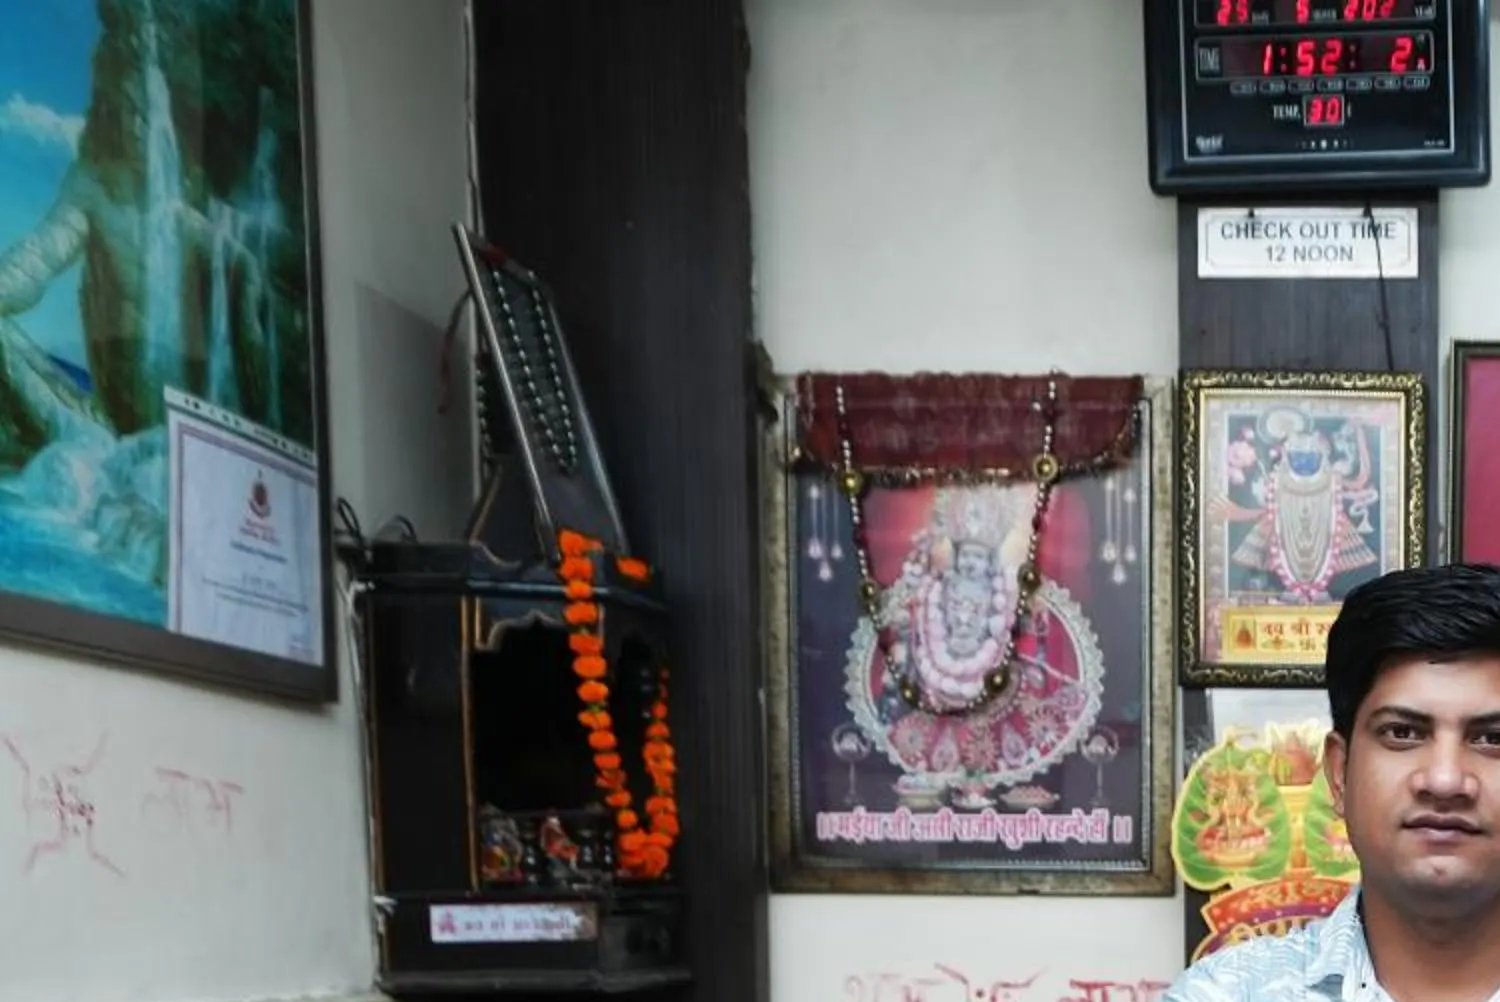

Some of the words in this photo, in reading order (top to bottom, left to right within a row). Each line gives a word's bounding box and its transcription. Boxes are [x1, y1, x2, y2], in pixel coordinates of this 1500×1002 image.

[1221, 222, 1292, 240] CHECK
[1300, 221, 1341, 239] OUT
[1350, 221, 1397, 240] TIME
[1264, 246, 1287, 262] 12
[1294, 245, 1354, 262] NOON
